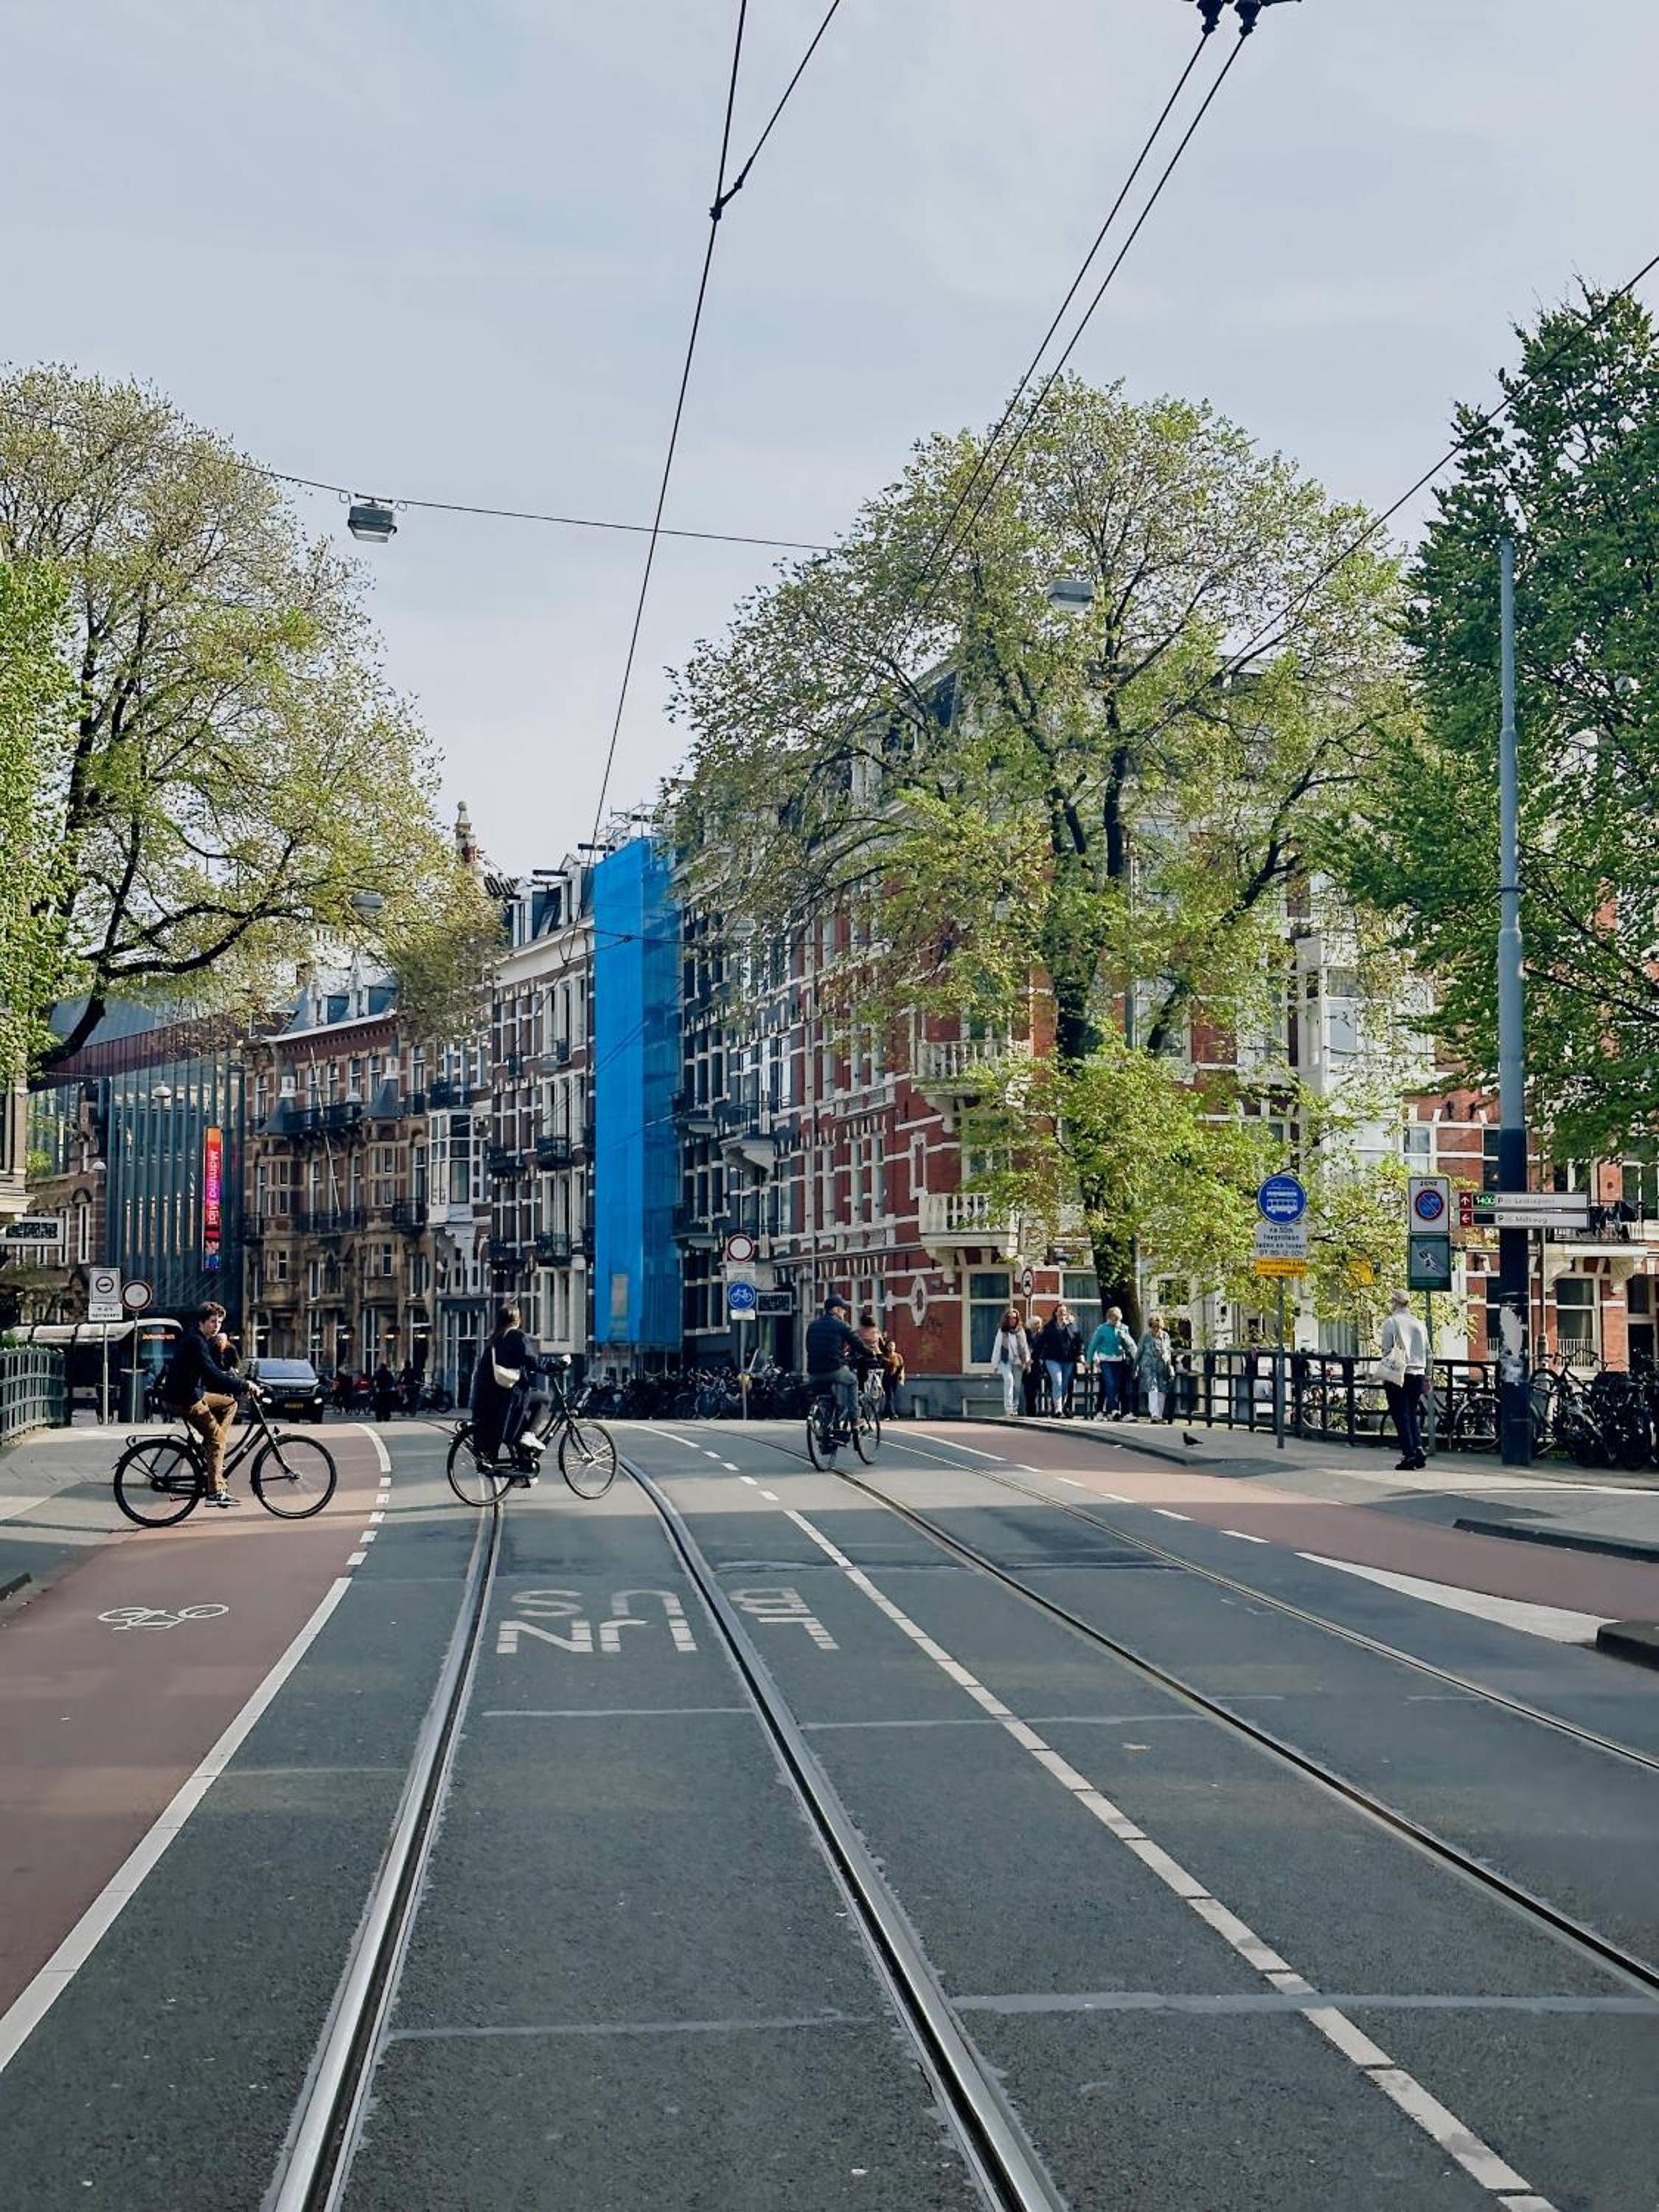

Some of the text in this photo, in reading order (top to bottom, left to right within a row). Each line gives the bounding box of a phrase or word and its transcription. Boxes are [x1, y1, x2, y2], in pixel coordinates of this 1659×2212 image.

[209, 1150, 219, 1225] Mamma Mia!
[511, 1587, 813, 1617] BUS
